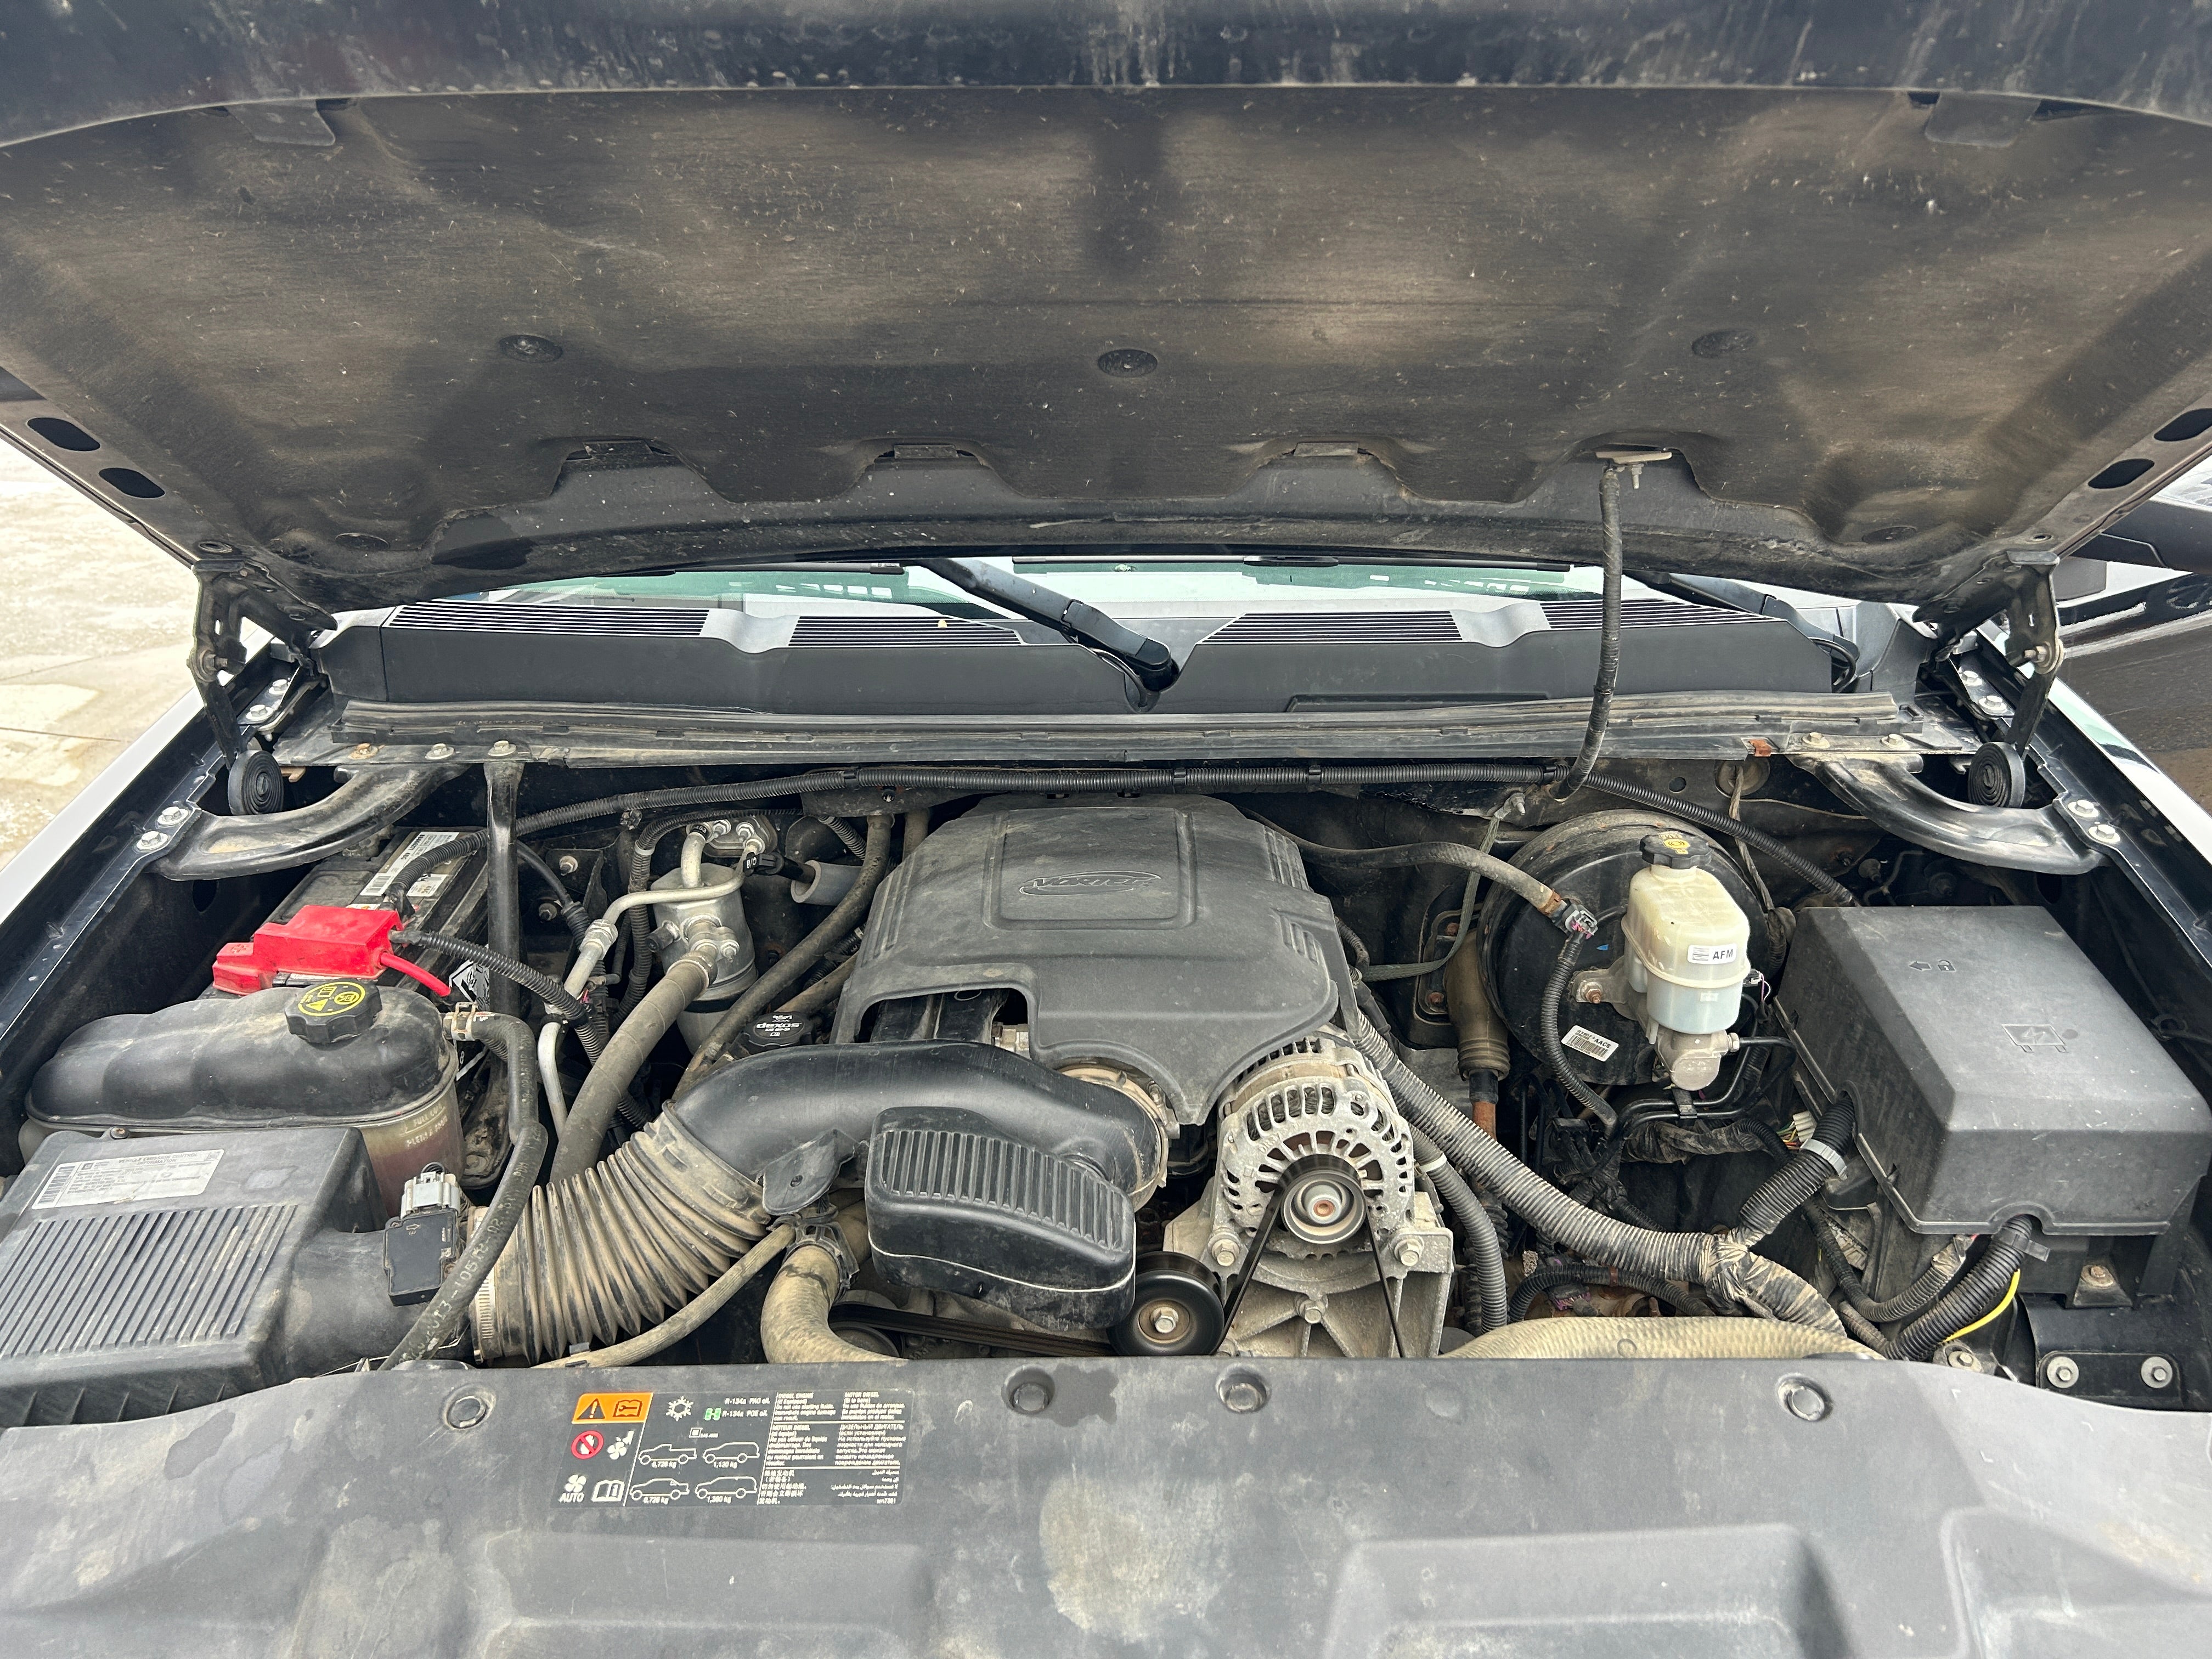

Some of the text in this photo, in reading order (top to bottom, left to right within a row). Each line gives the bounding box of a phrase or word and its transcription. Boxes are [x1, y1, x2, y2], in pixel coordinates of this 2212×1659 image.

[1712, 949, 1734, 960] AFM
[558, 1492, 584, 1503] AUTO
[723, 1496, 732, 1504] kg
